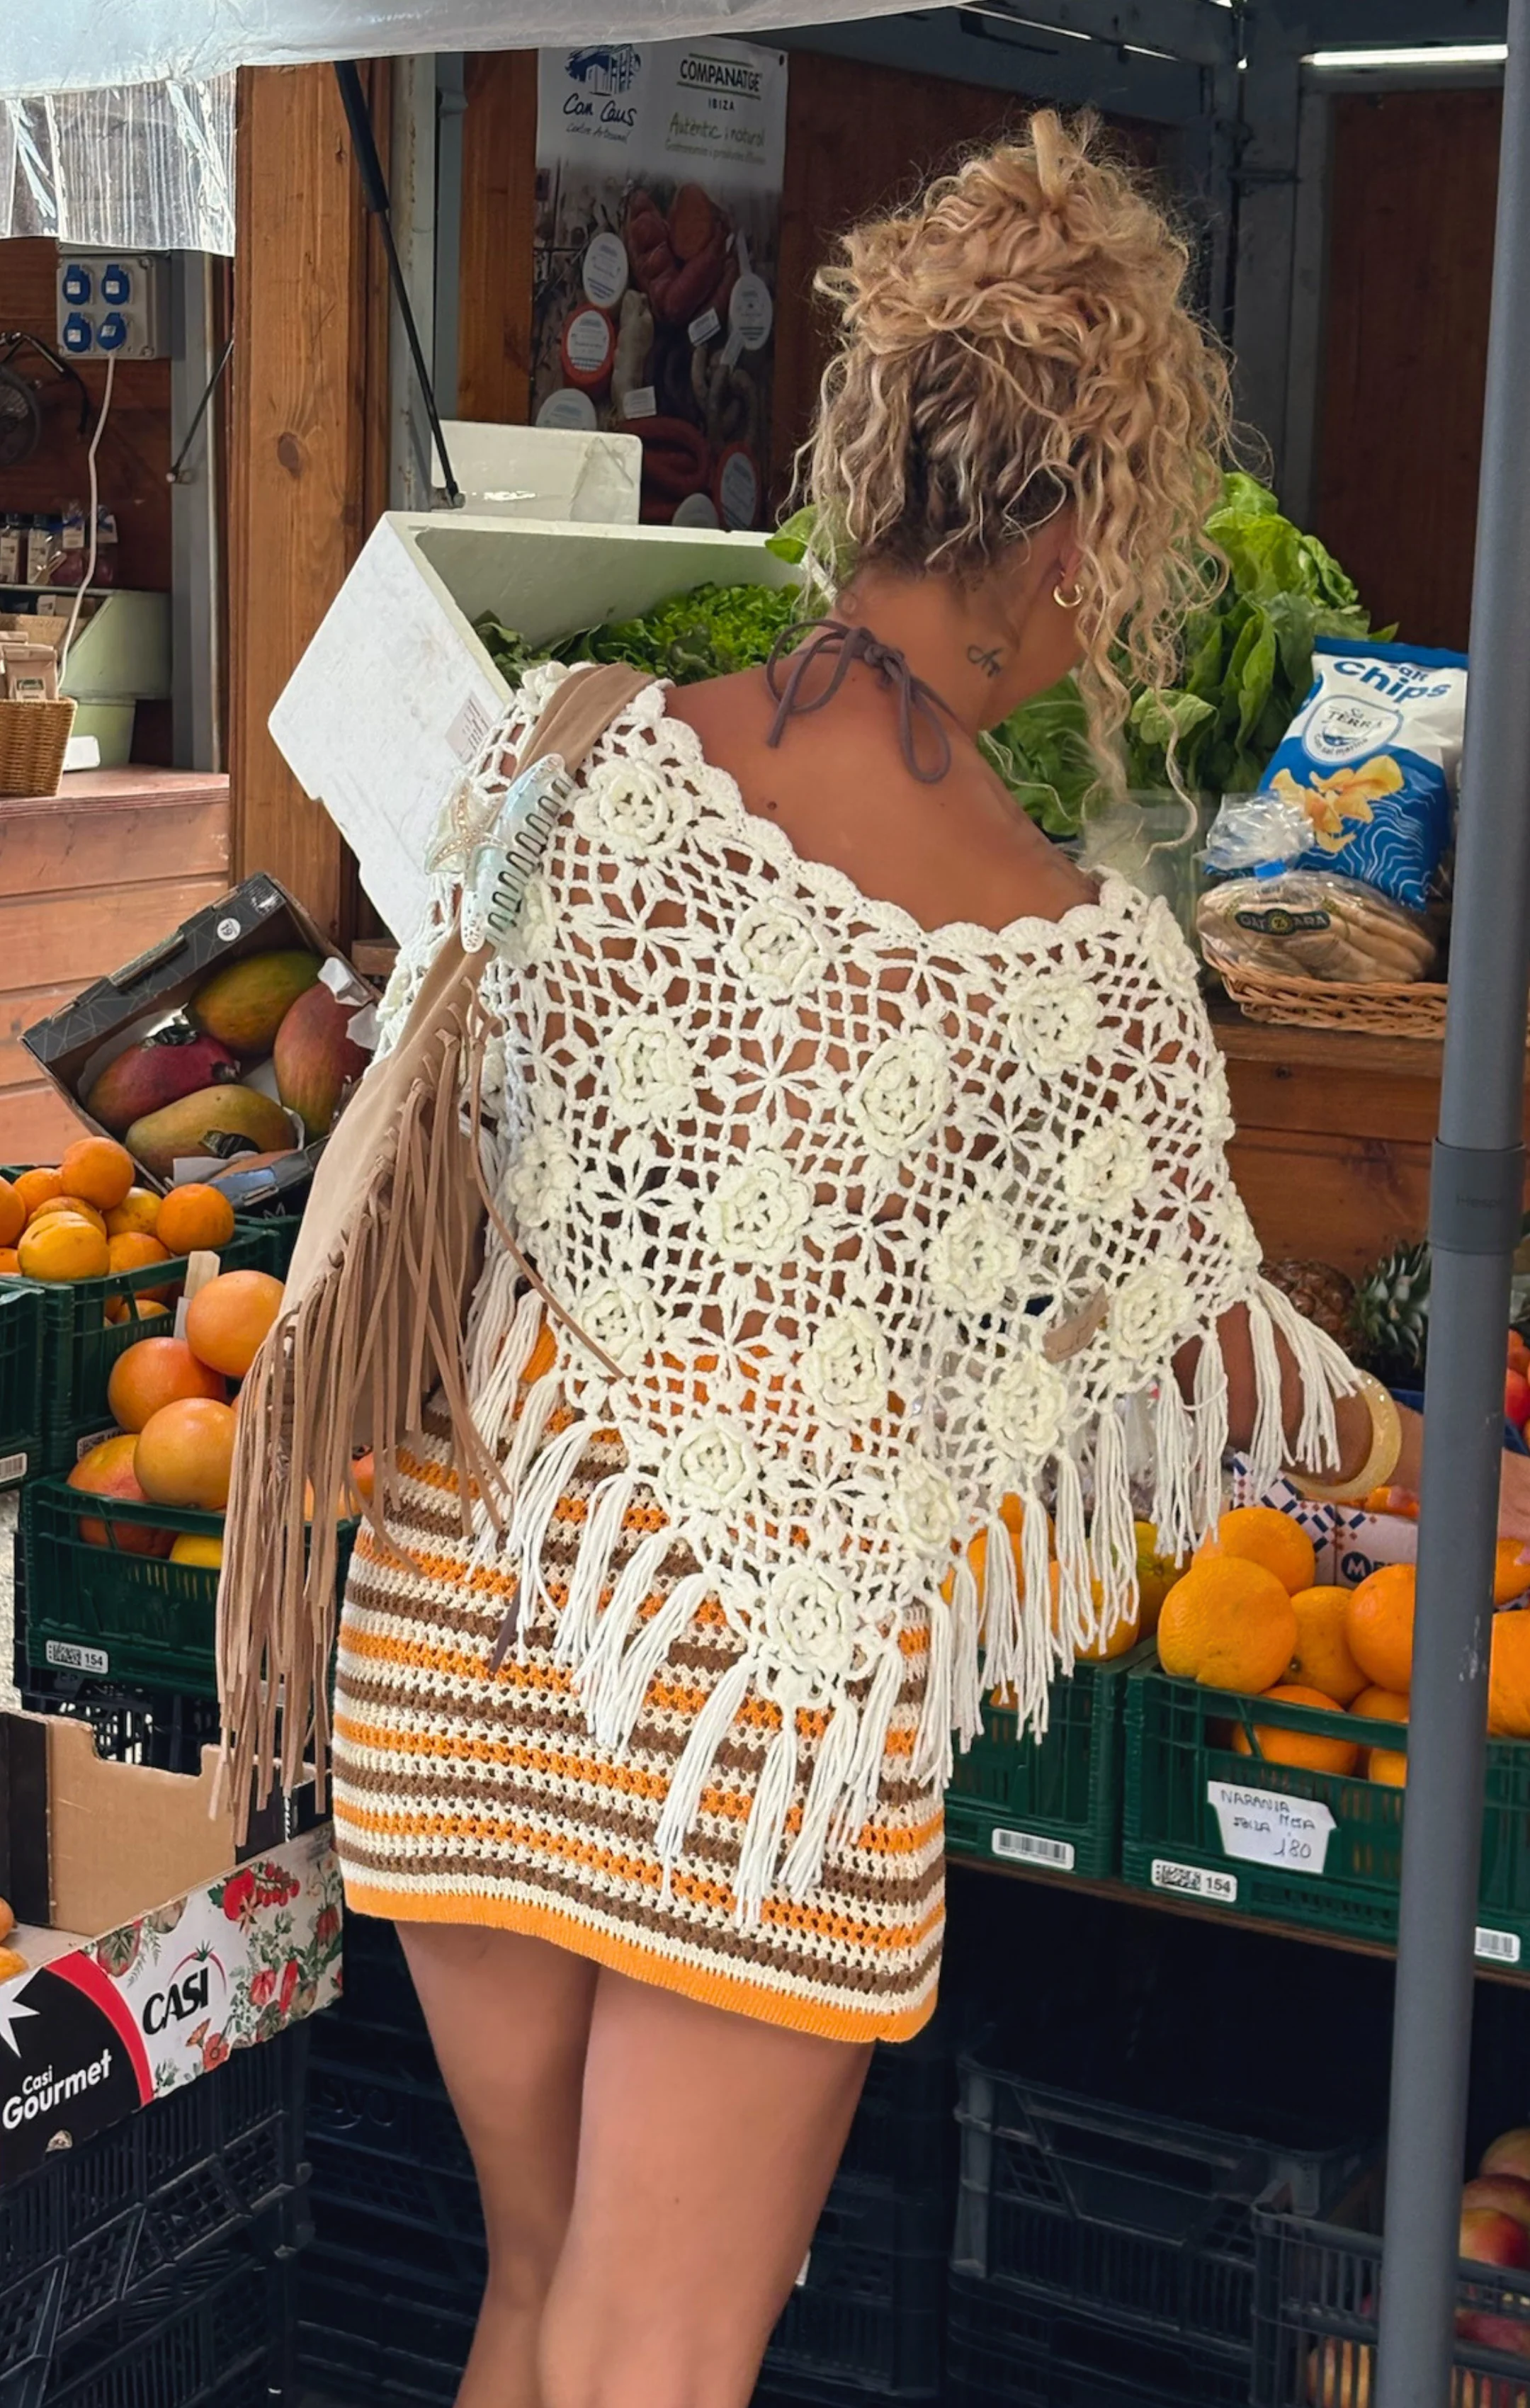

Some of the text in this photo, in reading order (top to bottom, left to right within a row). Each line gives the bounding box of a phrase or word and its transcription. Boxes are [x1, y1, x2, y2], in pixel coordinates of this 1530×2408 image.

[679, 59, 761, 93] COMPANATGE
[563, 92, 638, 126] Can Caus
[708, 96, 735, 111] IBIZA
[84, 1652, 103, 1667] 154
[1206, 1876, 1231, 1893] 154
[142, 1965, 209, 2035] CASI
[2, 2048, 113, 2130] Gourmet
[22, 2064, 53, 2095] Casi
